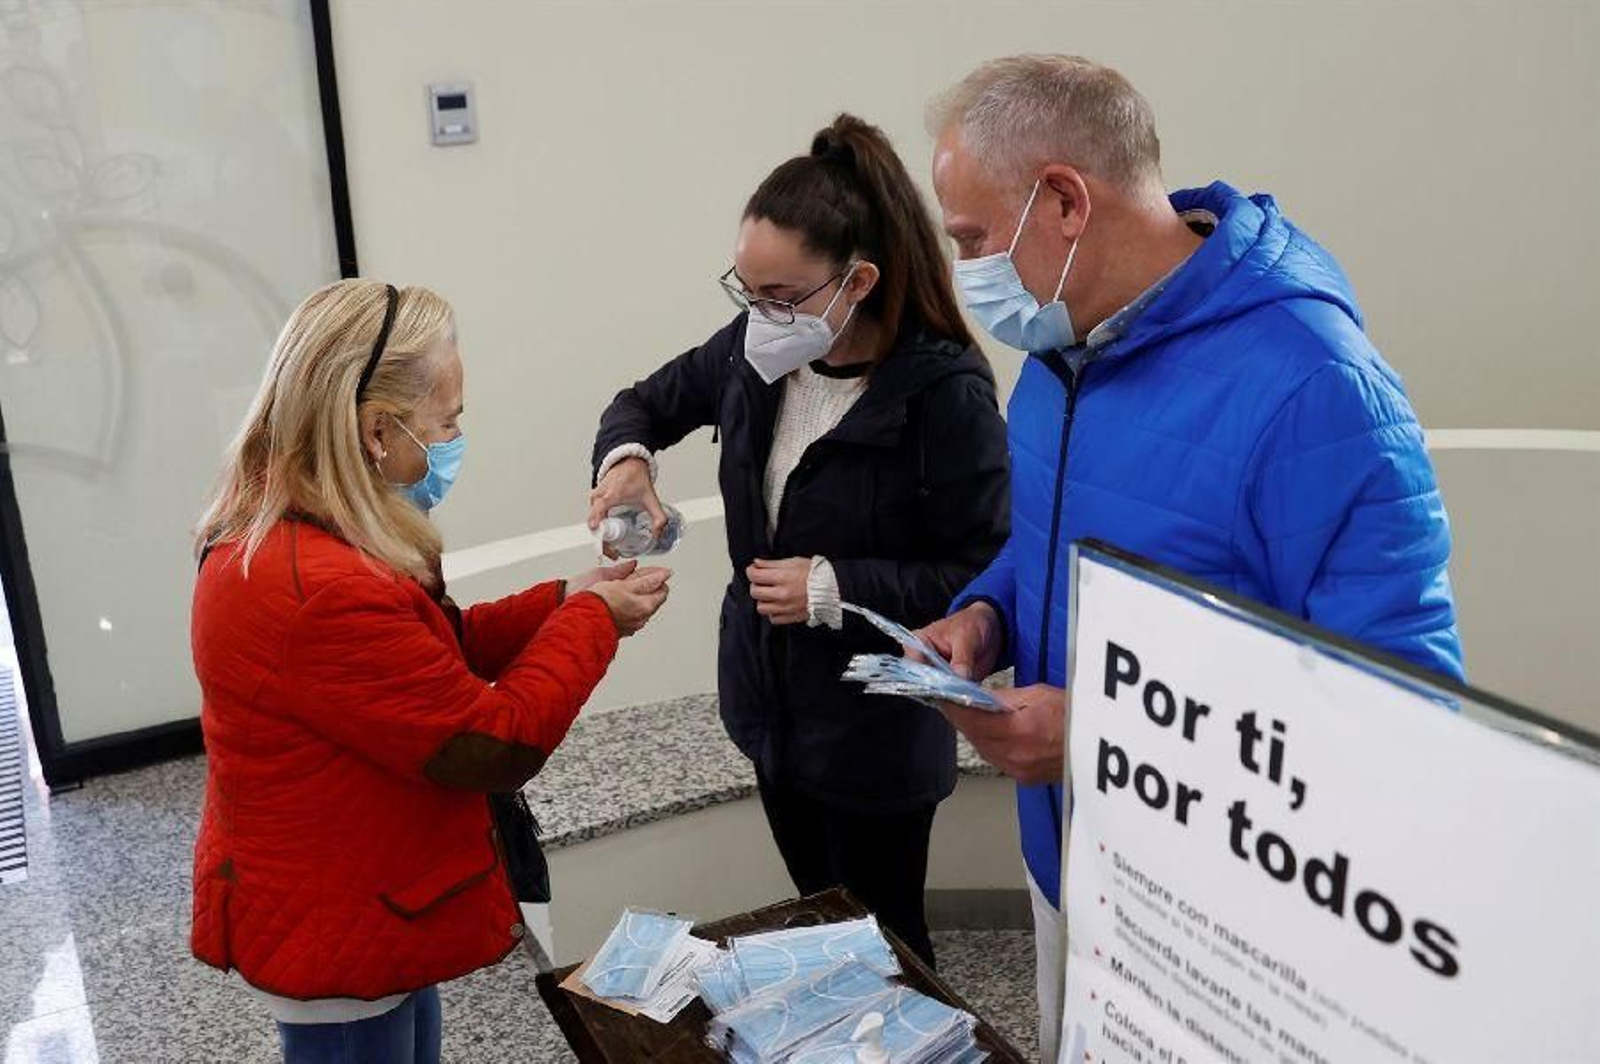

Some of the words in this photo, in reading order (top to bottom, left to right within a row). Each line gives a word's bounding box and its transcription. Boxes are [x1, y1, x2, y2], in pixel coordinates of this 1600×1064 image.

[1104, 640, 1210, 742] Por
[1236, 711, 1306, 810] ti,
[1097, 737, 1202, 826] por
[1227, 800, 1460, 979] todos
[1112, 851, 1173, 905] Siempre
[1177, 900, 1209, 928] con
[1213, 922, 1307, 992] mascarilla
[1104, 1000, 1153, 1052] Coloca
[1114, 904, 1181, 968] Recuerda
[1186, 959, 1242, 1010] lavarte
[1247, 1002, 1272, 1034] las
[1167, 999, 1180, 1022] la
[1102, 1021, 1142, 1062] hacia
